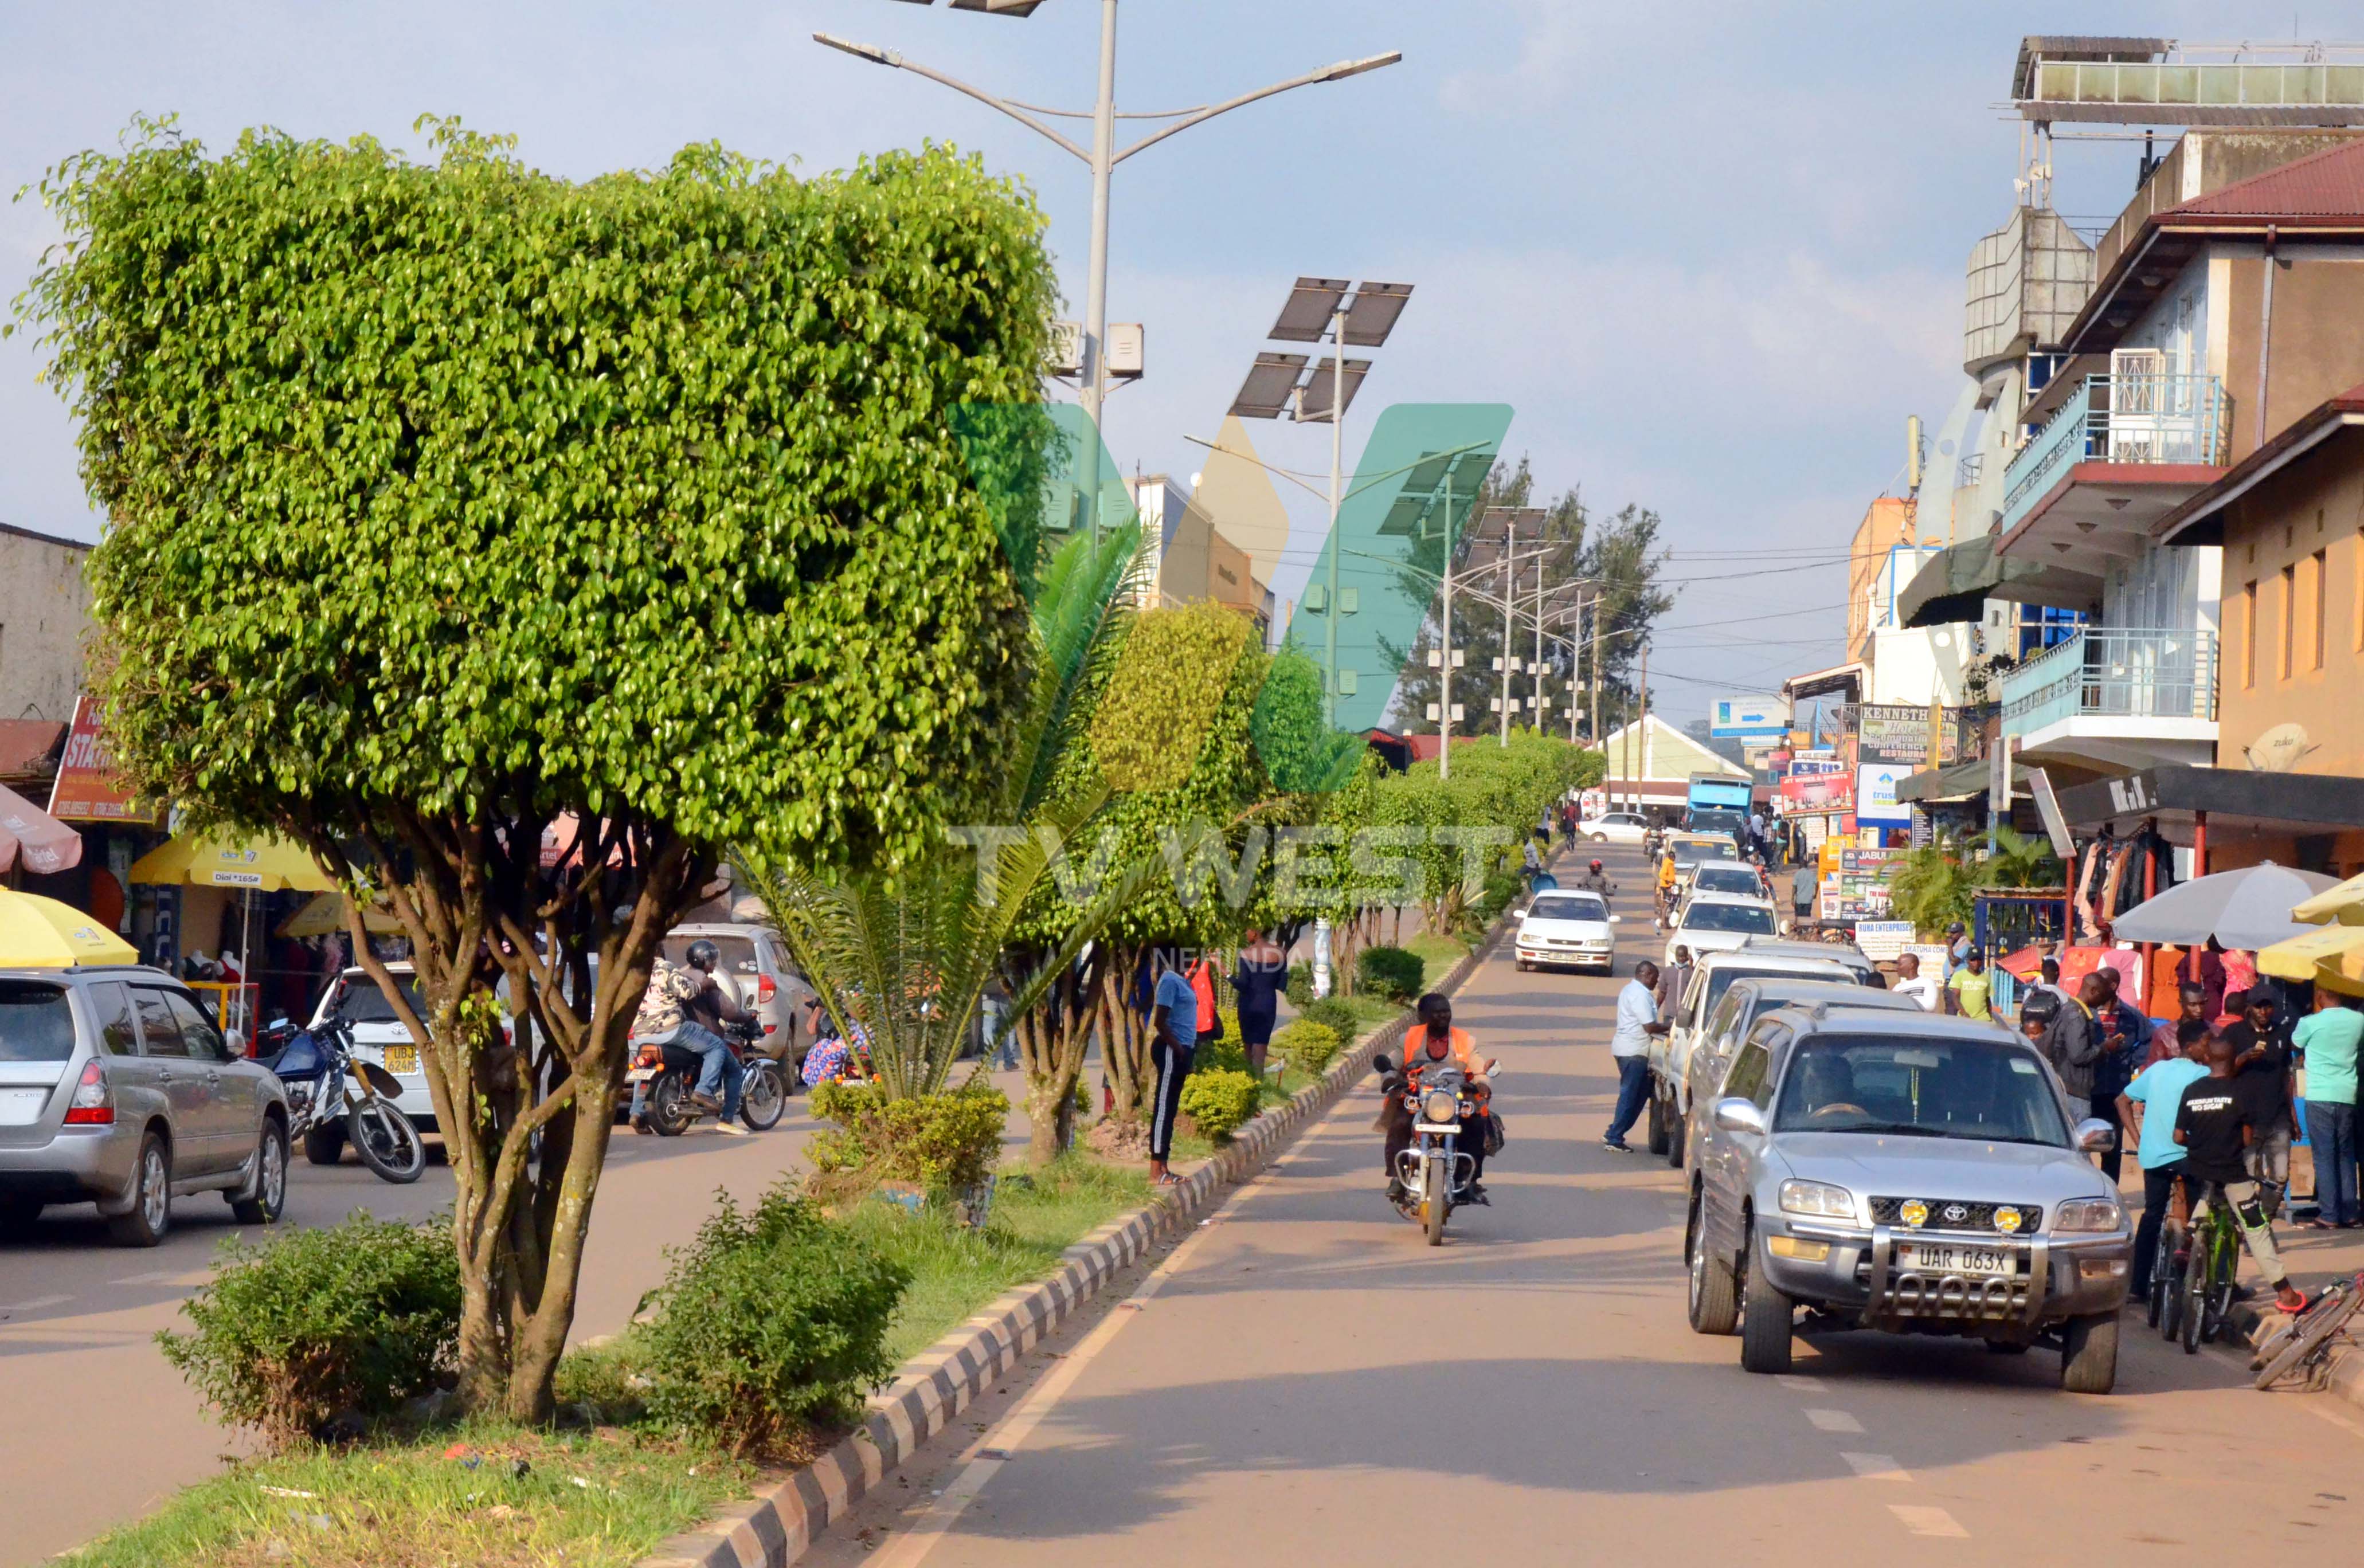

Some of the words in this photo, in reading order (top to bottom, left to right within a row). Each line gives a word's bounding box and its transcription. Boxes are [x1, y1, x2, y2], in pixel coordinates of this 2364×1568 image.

[1863, 707, 1928, 721] KENNETH
[1868, 742, 1925, 751] CONFERENCE
[1876, 923, 1913, 932] ENTERPRISES
[394, 1047, 414, 1059] UBJ
[388, 1060, 414, 1071] 624M
[2186, 1098, 2213, 1106] MAXIMUM
[2191, 1104, 2203, 1112] NO
[2203, 1103, 2224, 1111] SUGAR
[1921, 1248, 1953, 1268] UAR
[1963, 1250, 2006, 1271] 063X
